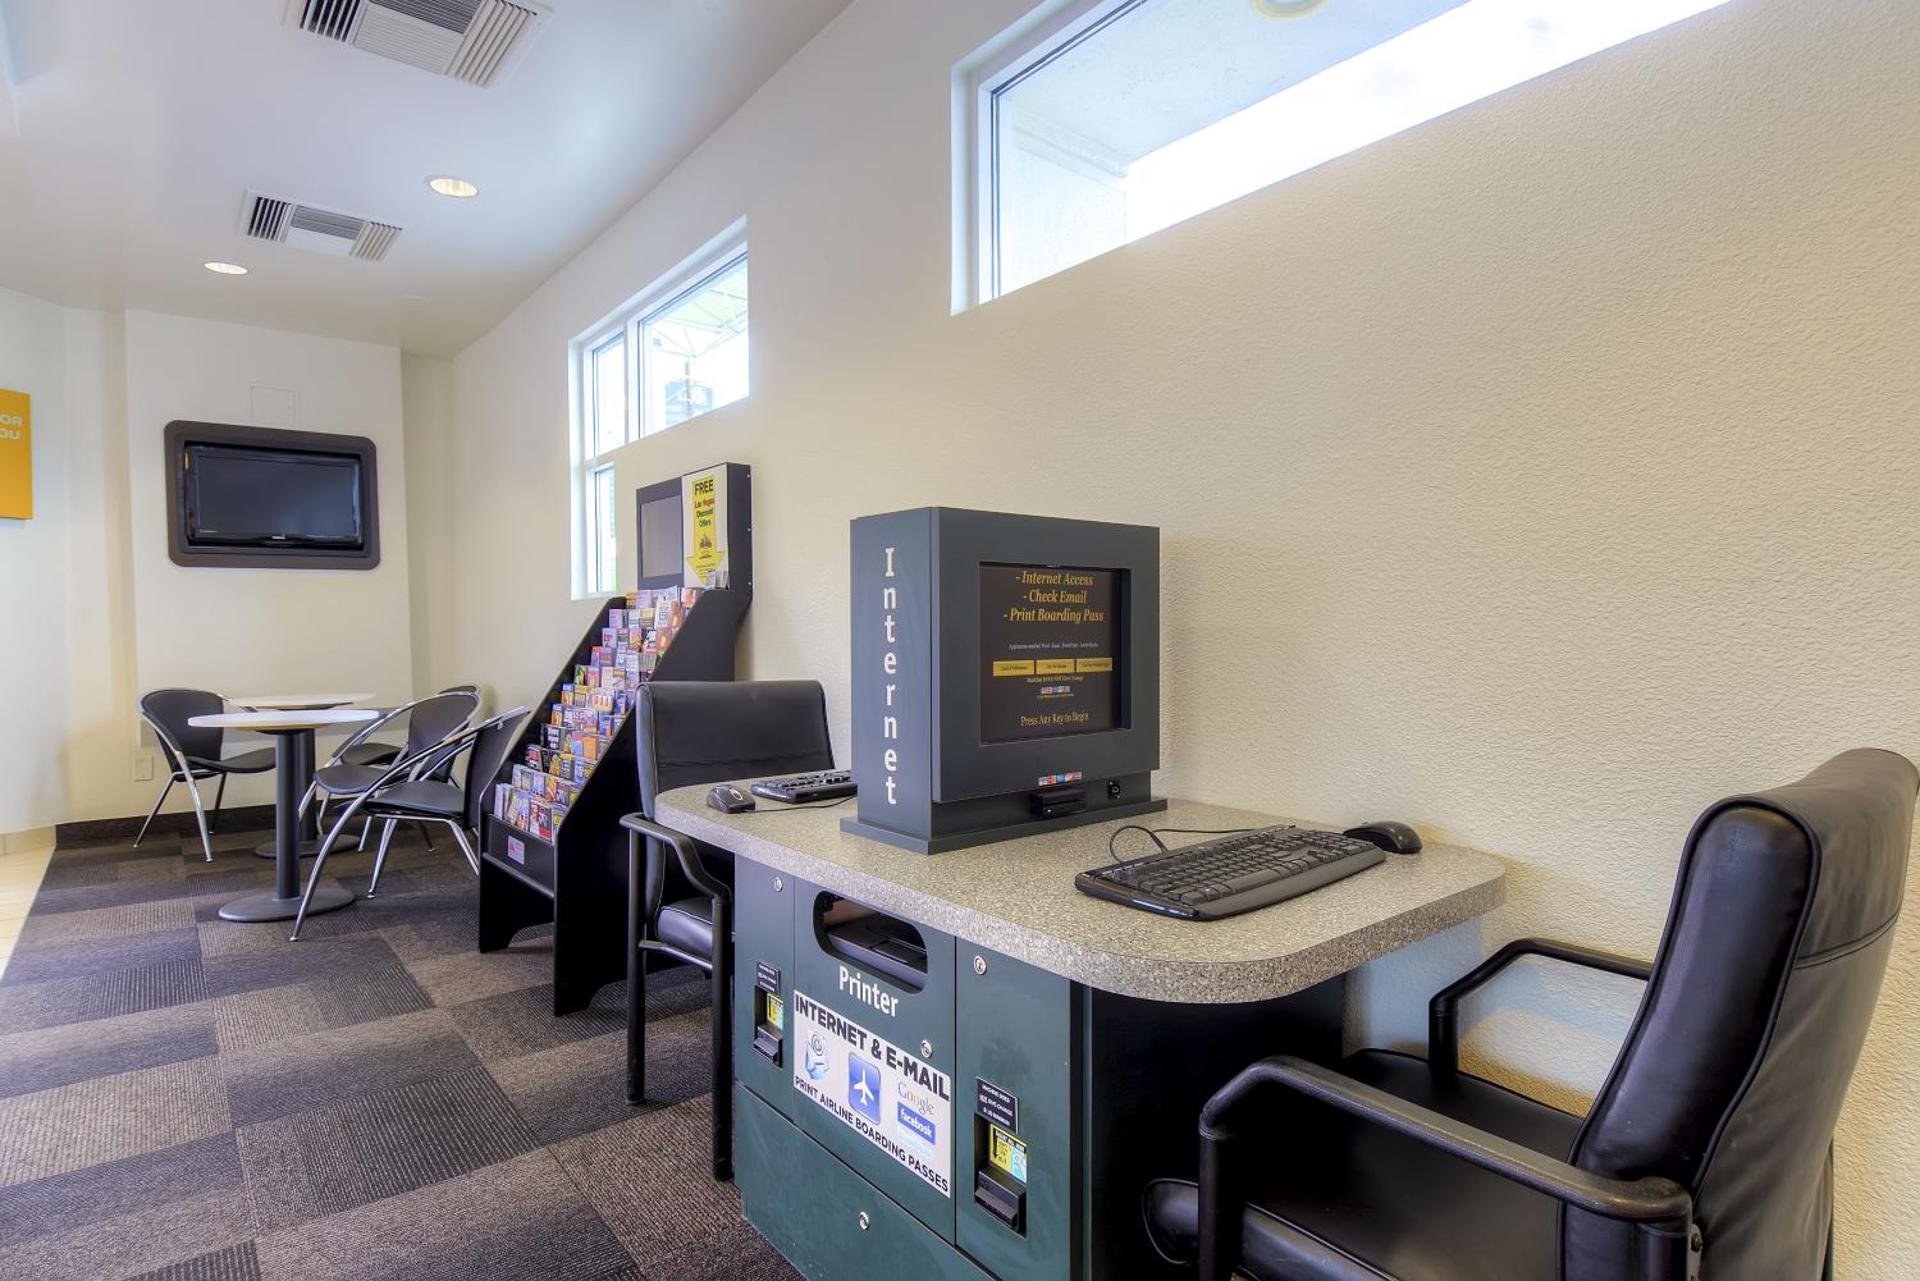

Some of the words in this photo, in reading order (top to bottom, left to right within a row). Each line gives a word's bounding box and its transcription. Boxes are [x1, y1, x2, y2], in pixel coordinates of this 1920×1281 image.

[694, 479, 714, 496] FREE
[1063, 573, 1095, 586] Access
[1029, 589, 1057, 603] Check
[1059, 590, 1088, 604] Email
[1010, 607, 1035, 621] Print
[1038, 607, 1082, 624] Boarding
[1083, 608, 1104, 622] Pass
[883, 547, 898, 805] Internet
[1020, 715, 1038, 727] Press
[1039, 715, 1052, 726] Any
[1052, 713, 1064, 725] Key
[1072, 710, 1089, 723] Begin
[839, 966, 899, 1017] Printer
[795, 994, 867, 1050] INTERNET
[870, 1038, 882, 1060] &
[886, 1045, 950, 1102] E-MAIL
[897, 1081, 936, 1115] Google
[795, 1076, 818, 1097] PRINT
[820, 1093, 853, 1125] AIRLINE
[855, 1117, 906, 1162] BOARDING
[908, 1155, 949, 1193] PASSES
[900, 1108, 933, 1138] facebook
